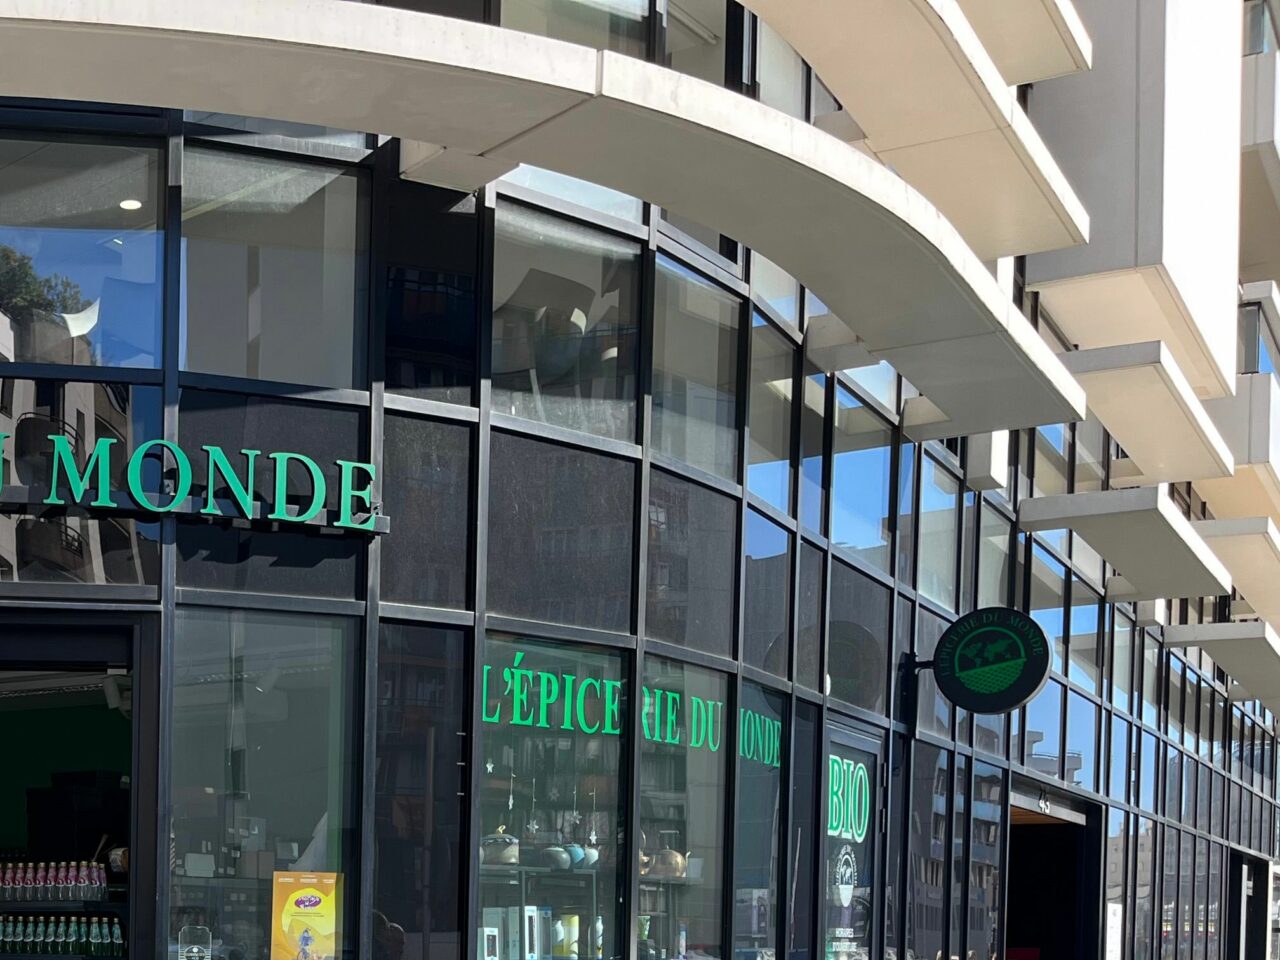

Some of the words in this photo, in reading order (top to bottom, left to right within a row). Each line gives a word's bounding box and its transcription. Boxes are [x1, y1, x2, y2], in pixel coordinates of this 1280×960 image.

[43, 434, 380, 531] MONDE
[982, 612, 1003, 624] DU
[1007, 614, 1044, 656] MONDE
[690, 695, 723, 752] DU
[739, 706, 781, 768] ONDE
[827, 753, 870, 844] BIO
